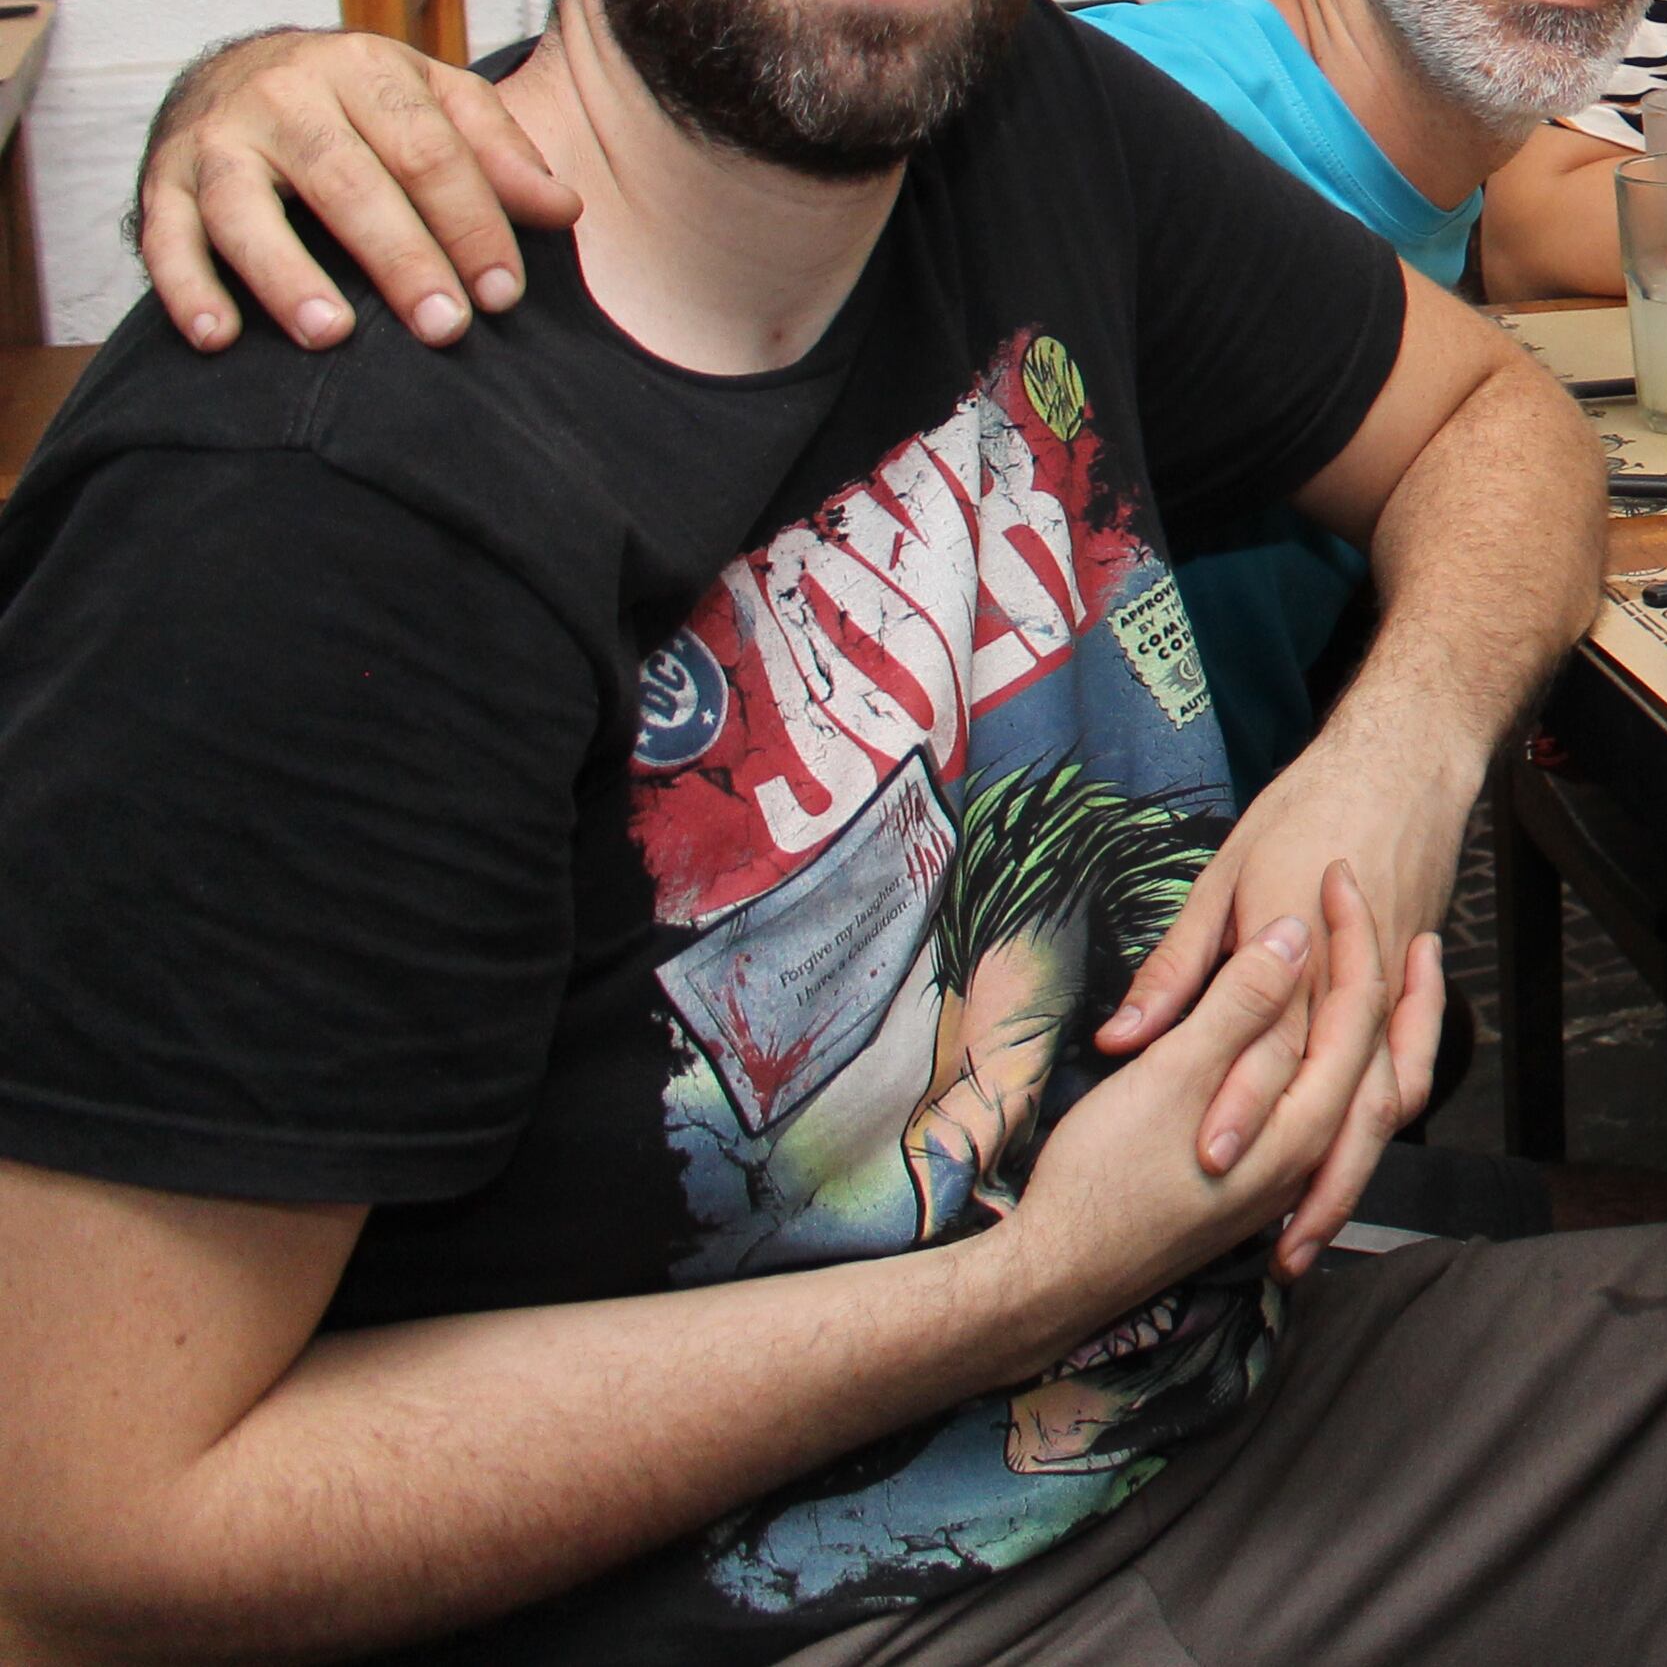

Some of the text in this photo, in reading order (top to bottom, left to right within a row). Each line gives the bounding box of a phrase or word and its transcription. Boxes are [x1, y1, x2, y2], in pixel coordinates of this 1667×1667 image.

[1138, 617, 1156, 635] BY
[640, 649, 688, 723] DC
[779, 942, 833, 988] Forgive
[834, 920, 856, 948] my
[803, 968, 840, 1000] have
